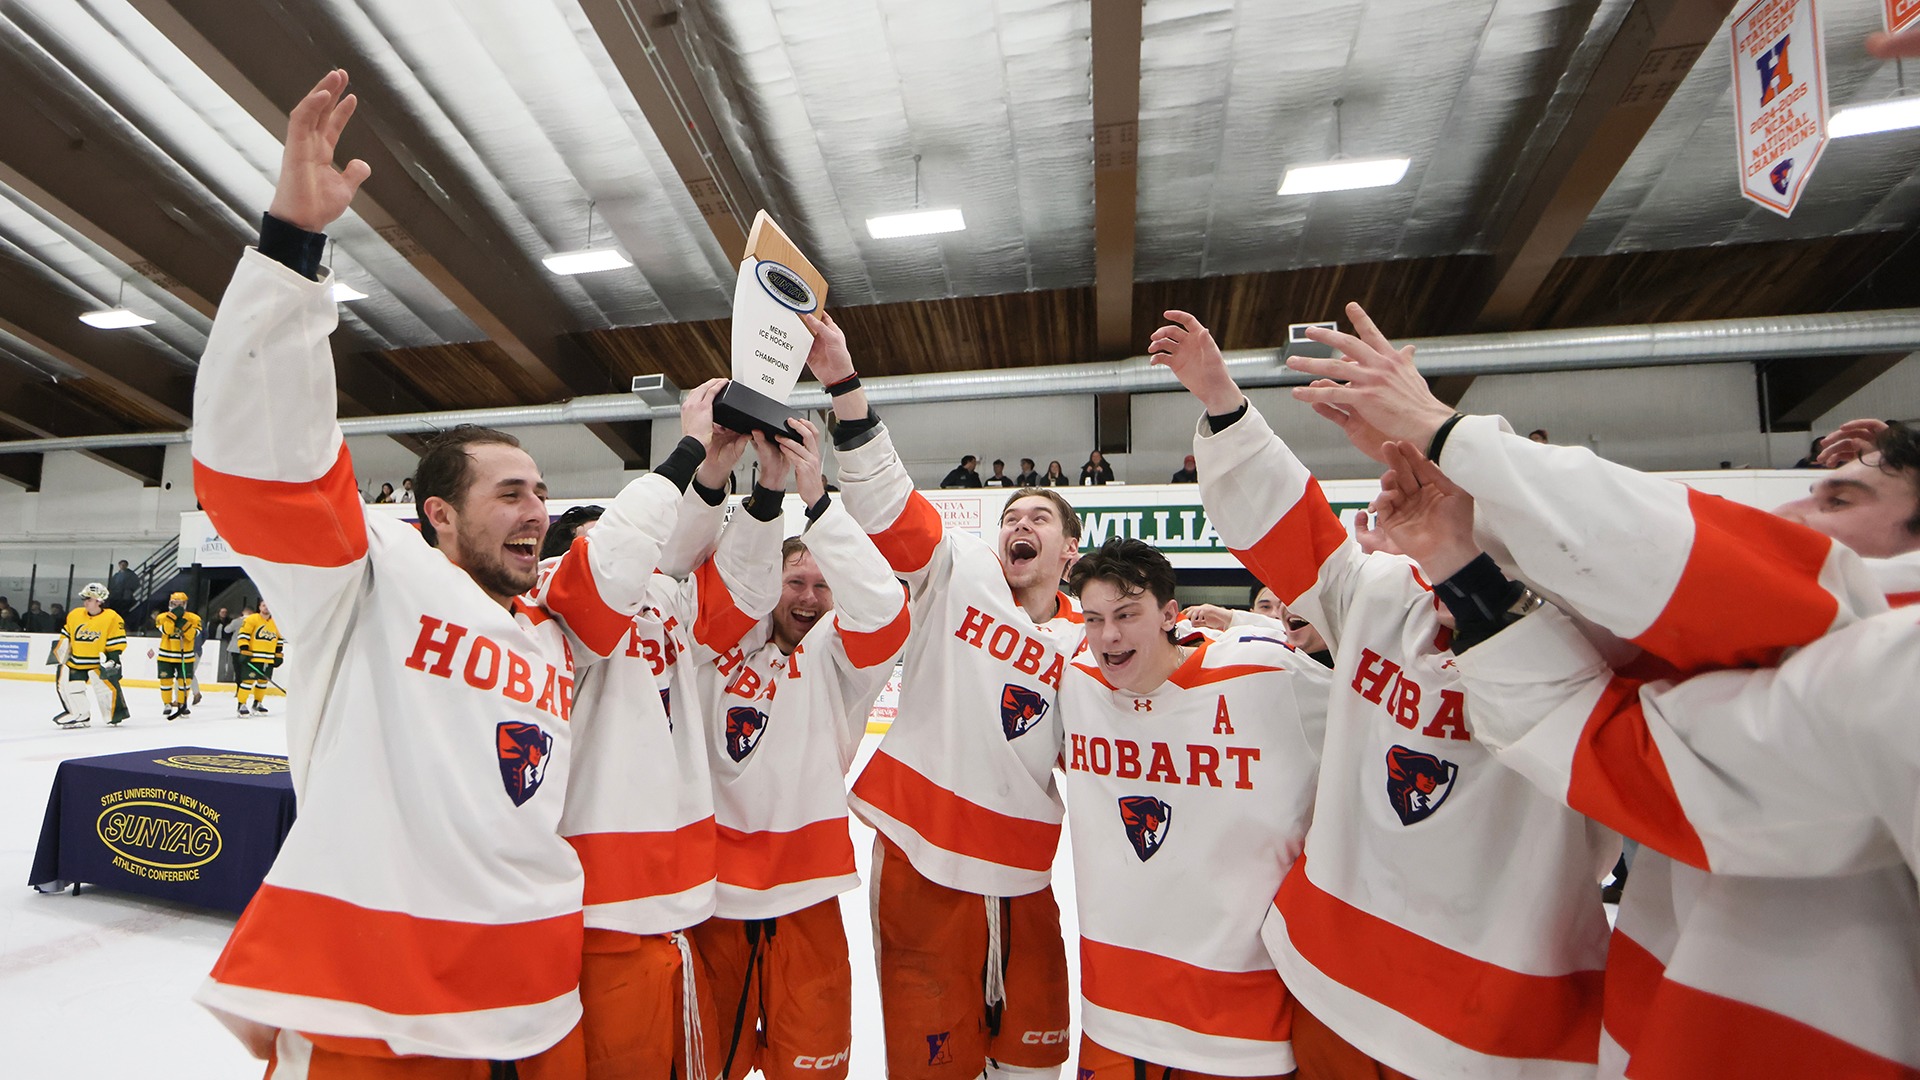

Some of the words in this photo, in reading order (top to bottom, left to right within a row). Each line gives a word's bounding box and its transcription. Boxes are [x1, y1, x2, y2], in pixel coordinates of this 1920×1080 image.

[1740, 0, 1800, 54] STATESM
[1748, 0, 1783, 31] HOBA
[1750, 9, 1795, 58] HOCKEY
[1750, 82, 1808, 134] 2024-2025
[1765, 108, 1795, 138] NCAA
[1748, 121, 1817, 177] CHAMPIONS
[1752, 112, 1810, 160] NATIONAL
[758, 329, 769, 339] ICE
[769, 335, 794, 351] HOCKEY
[769, 325, 788, 339] MEN'S
[754, 350, 790, 371] CHAMPIONS
[761, 373, 775, 385] 2026
[935, 502, 965, 510] NEVA
[943, 511, 979, 519] ERALS
[1080, 510, 1226, 548] WILLIA
[954, 605, 1065, 691] HOBA
[405, 614, 574, 721] HOBAR
[1213, 694, 1235, 735] A
[1070, 733, 1260, 790] HOBART
[101, 791, 123, 807] STATE
[124, 788, 167, 799] UNIVERSITY
[167, 791, 179, 802] OF
[180, 794, 199, 809] NEW
[198, 801, 221, 823] YORK
[105, 812, 213, 857] SUNYAC
[112, 856, 147, 877] ATHLETIC
[148, 869, 200, 881] CONFERENCE
[1021, 1028, 1070, 1044] CCM
[793, 1046, 849, 1070] CCM
